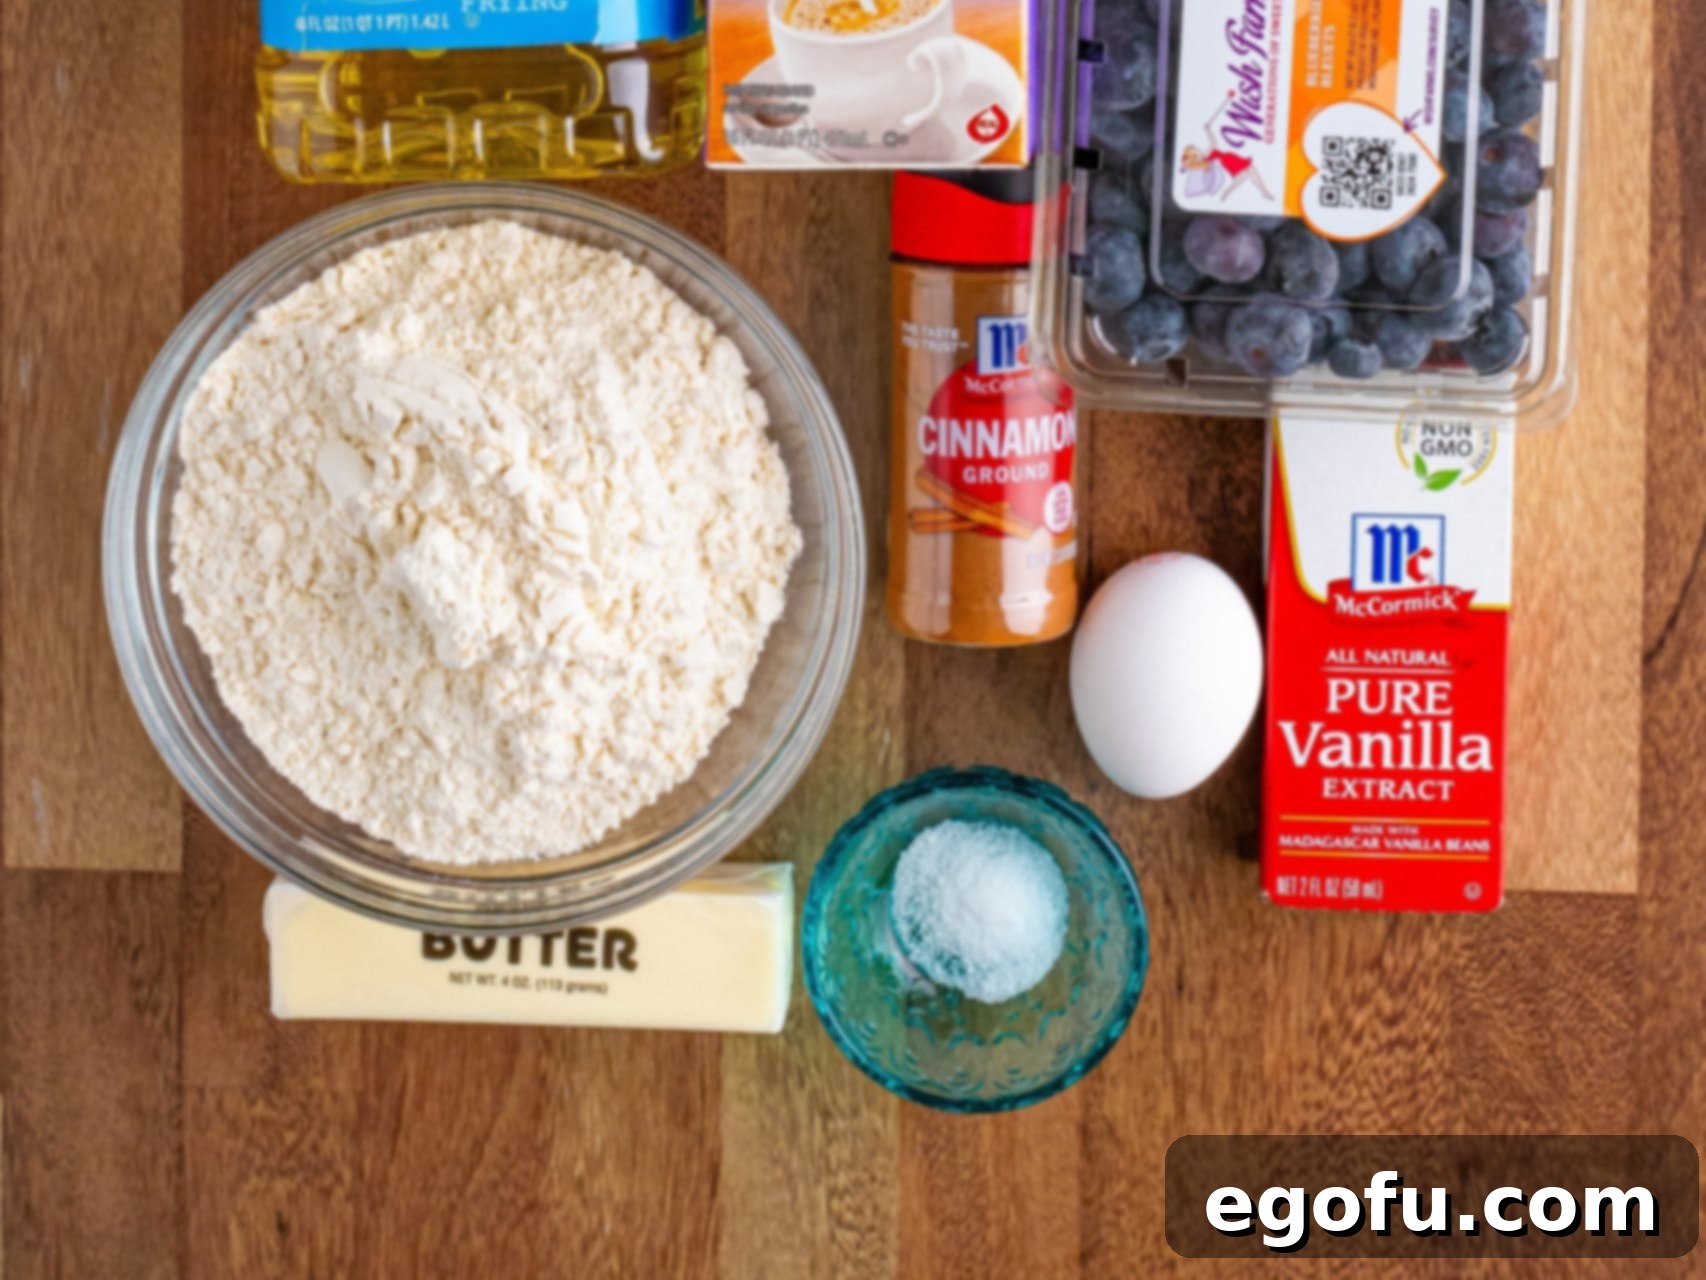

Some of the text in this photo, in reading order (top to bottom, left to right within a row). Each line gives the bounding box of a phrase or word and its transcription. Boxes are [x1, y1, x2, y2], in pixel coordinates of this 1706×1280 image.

[1221, 61, 1264, 148] Wish
[1264, 59, 1280, 145] GENERATIONS
[918, 412, 1077, 458] CINNAMON
[1420, 420, 1472, 437] NON
[1420, 440, 1474, 457] GMO
[962, 462, 1050, 485] GROUND
[1333, 591, 1460, 618] McCormick
[1325, 648, 1450, 666] ALL NATURAL
[1325, 677, 1454, 716] PURE
[1277, 719, 1494, 772] Vanilla
[1321, 777, 1454, 801] EXTRACT
[1279, 834, 1491, 853] MADAGASCAR VANILLA BEANS
[421, 925, 639, 972] BUTTER
[449, 972, 609, 996] NET WT. 4 OZ. (113 grams)
